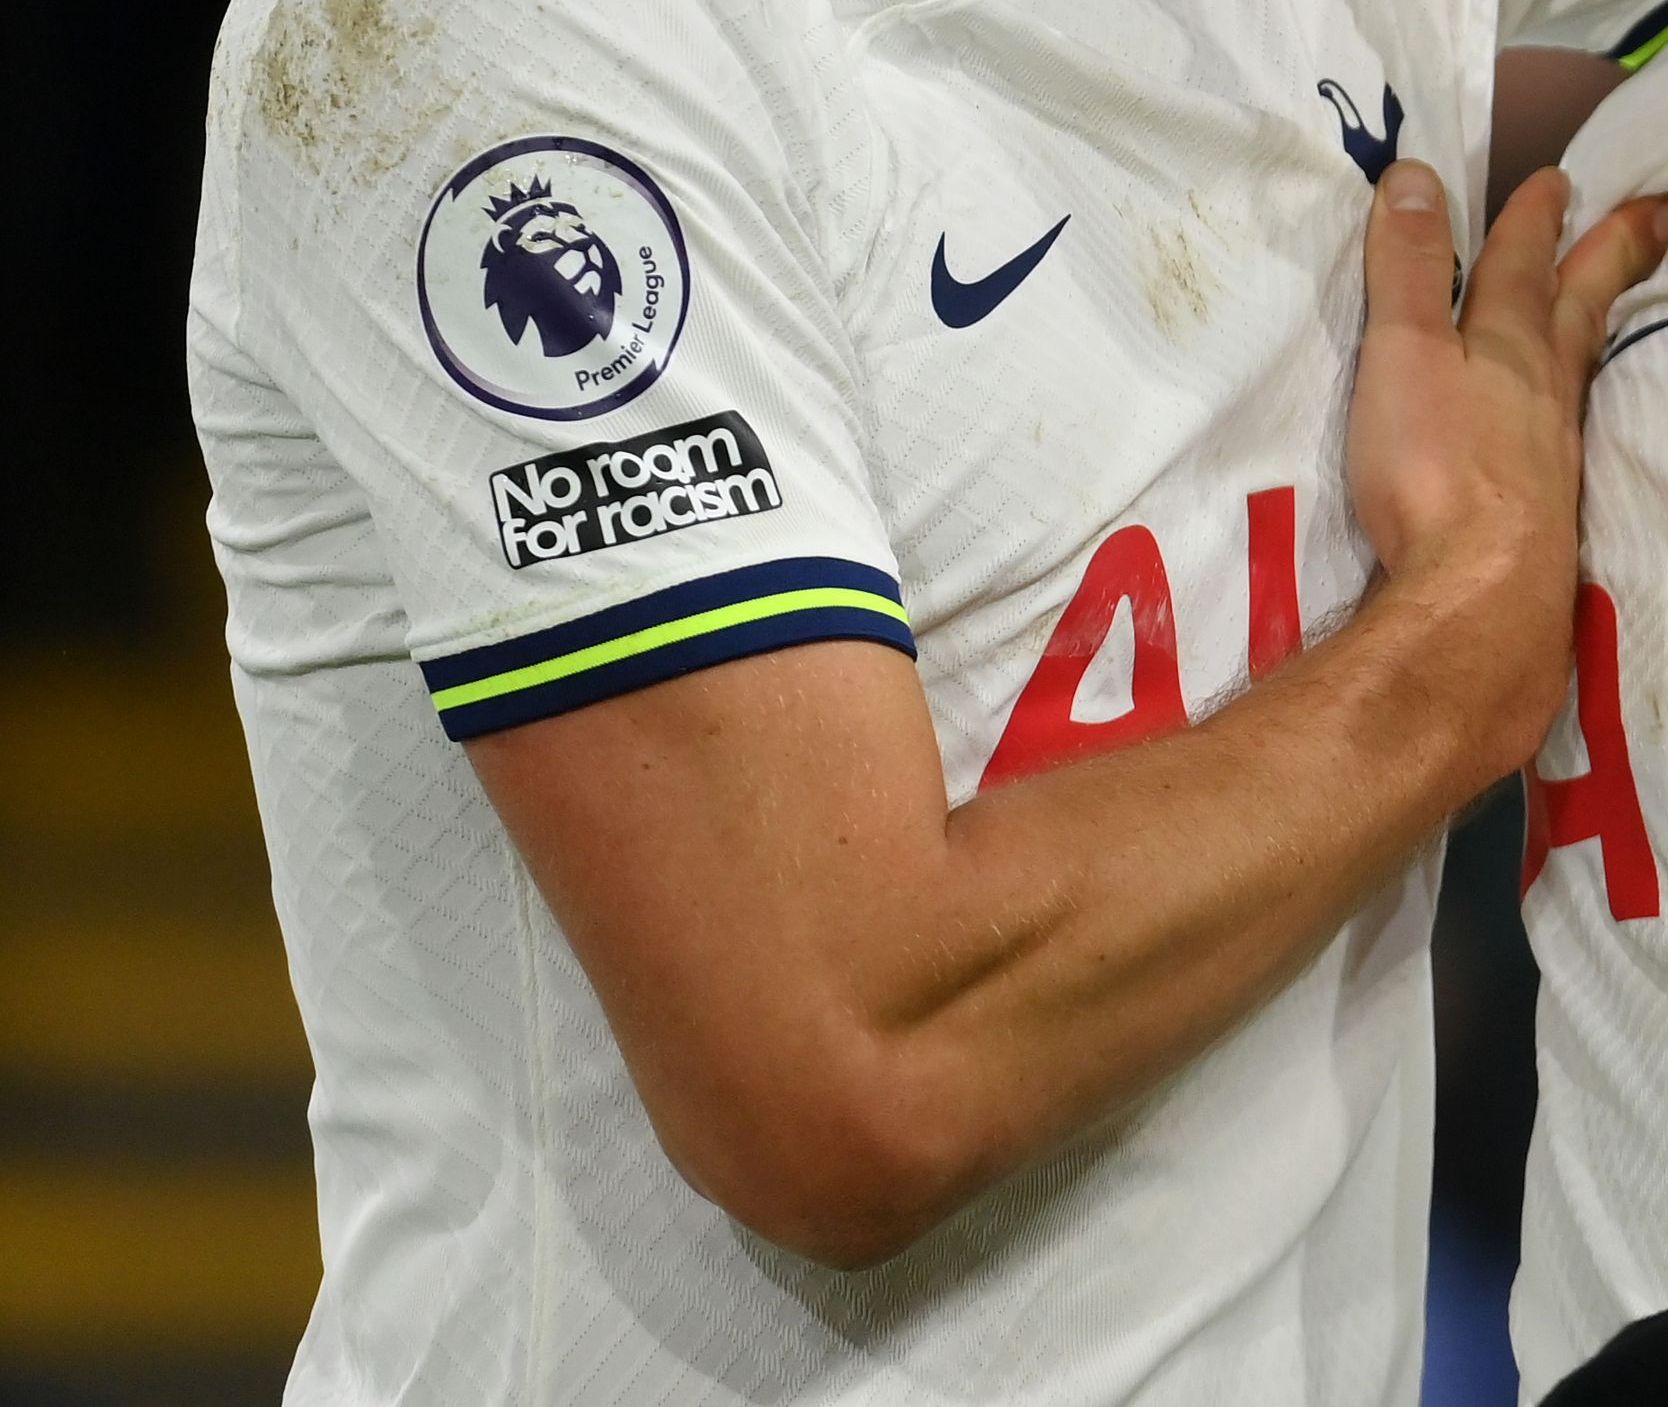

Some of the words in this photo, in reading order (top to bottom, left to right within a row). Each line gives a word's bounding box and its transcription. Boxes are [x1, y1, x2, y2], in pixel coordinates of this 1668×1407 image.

[574, 333, 646, 391] Premier
[632, 246, 665, 334] League
[491, 463, 582, 521] No
[586, 427, 742, 499] room
[501, 508, 588, 567] for
[597, 468, 781, 545] racism
